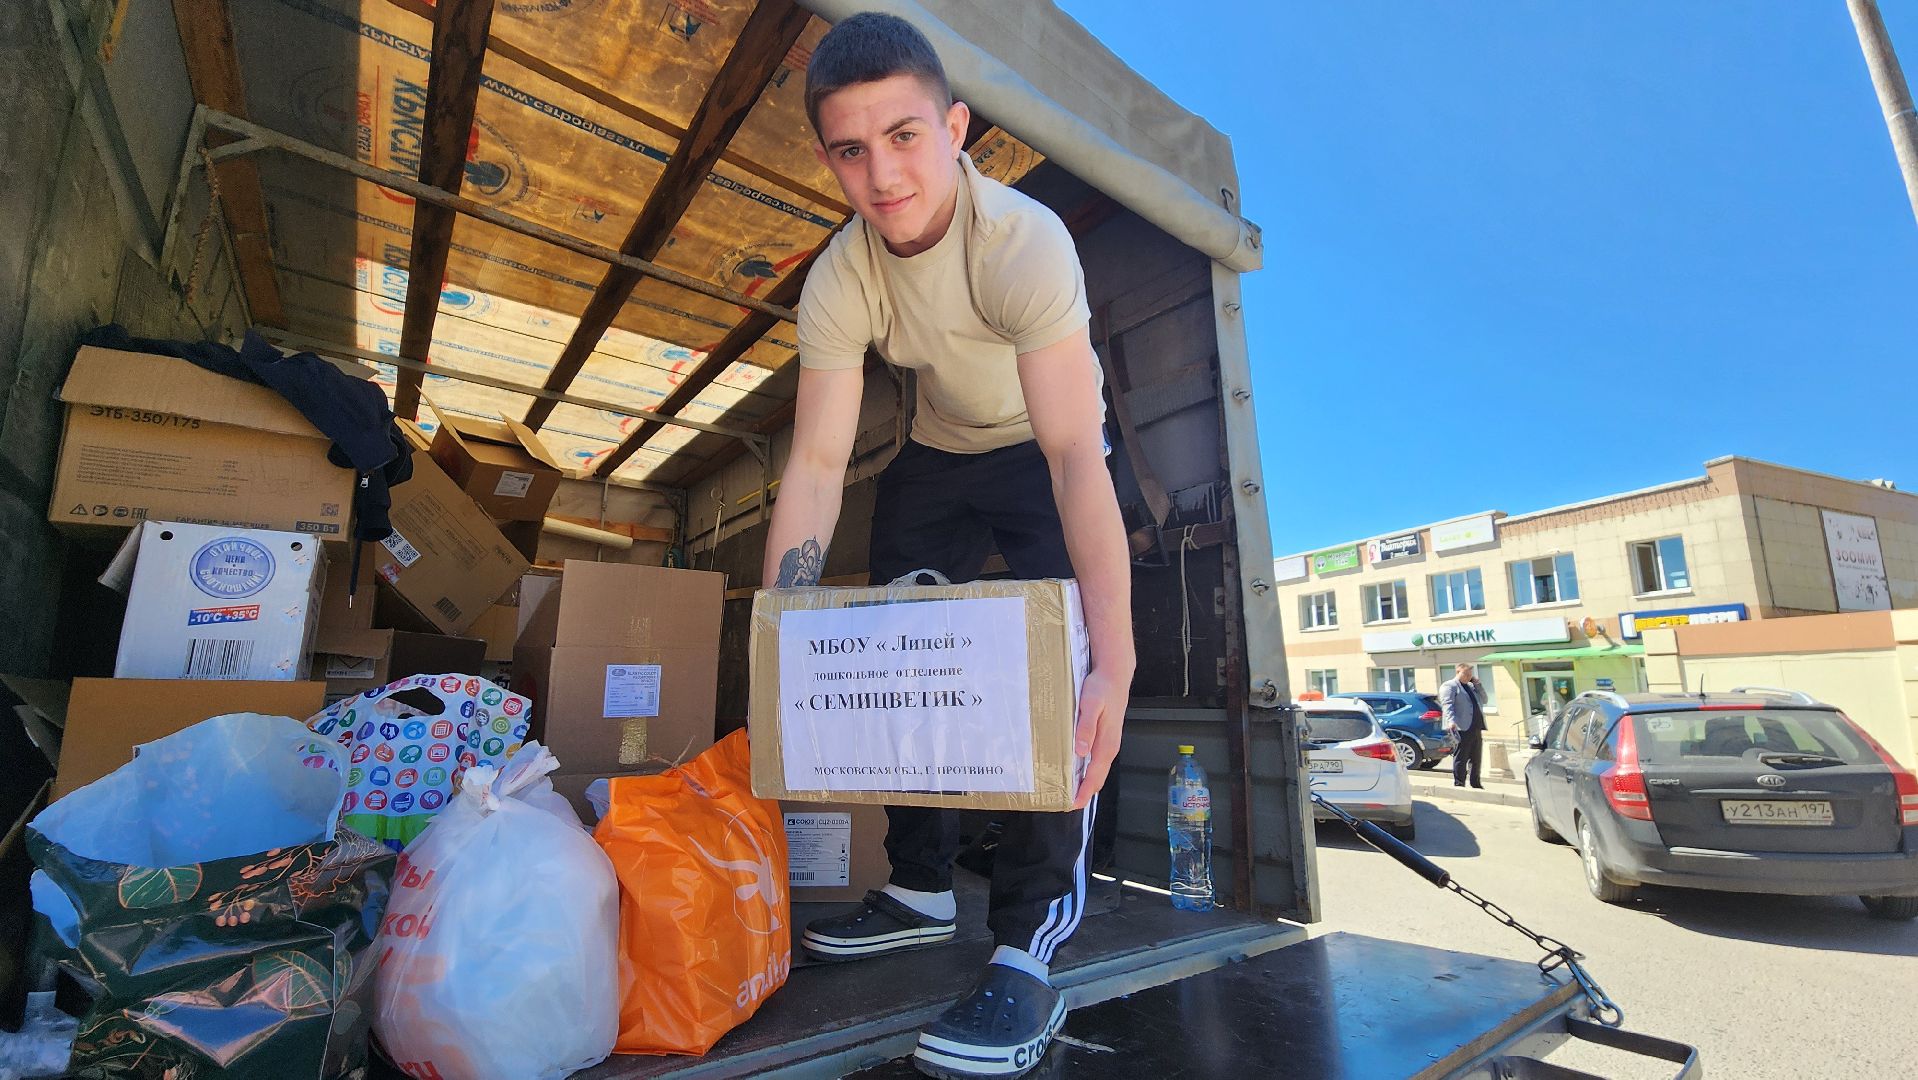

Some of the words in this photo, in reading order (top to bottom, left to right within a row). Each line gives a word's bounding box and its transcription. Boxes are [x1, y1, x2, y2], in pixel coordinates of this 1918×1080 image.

[299, 523, 320, 531] 350
[808, 636, 871, 657] МБОУ
[891, 632, 956, 652] Лицей
[1428, 629, 1497, 646] СБЕРБАНК
[812, 668, 889, 682] дошкольное
[895, 666, 963, 679] отделение
[809, 690, 967, 712] СЕМИЦВЕТИК
[814, 765, 892, 776] МОСКОВСКАЯ
[937, 765, 1004, 776] ПРОТВИНО
[1731, 803, 1798, 818] У213АН
[1801, 803, 1826, 814] 197
